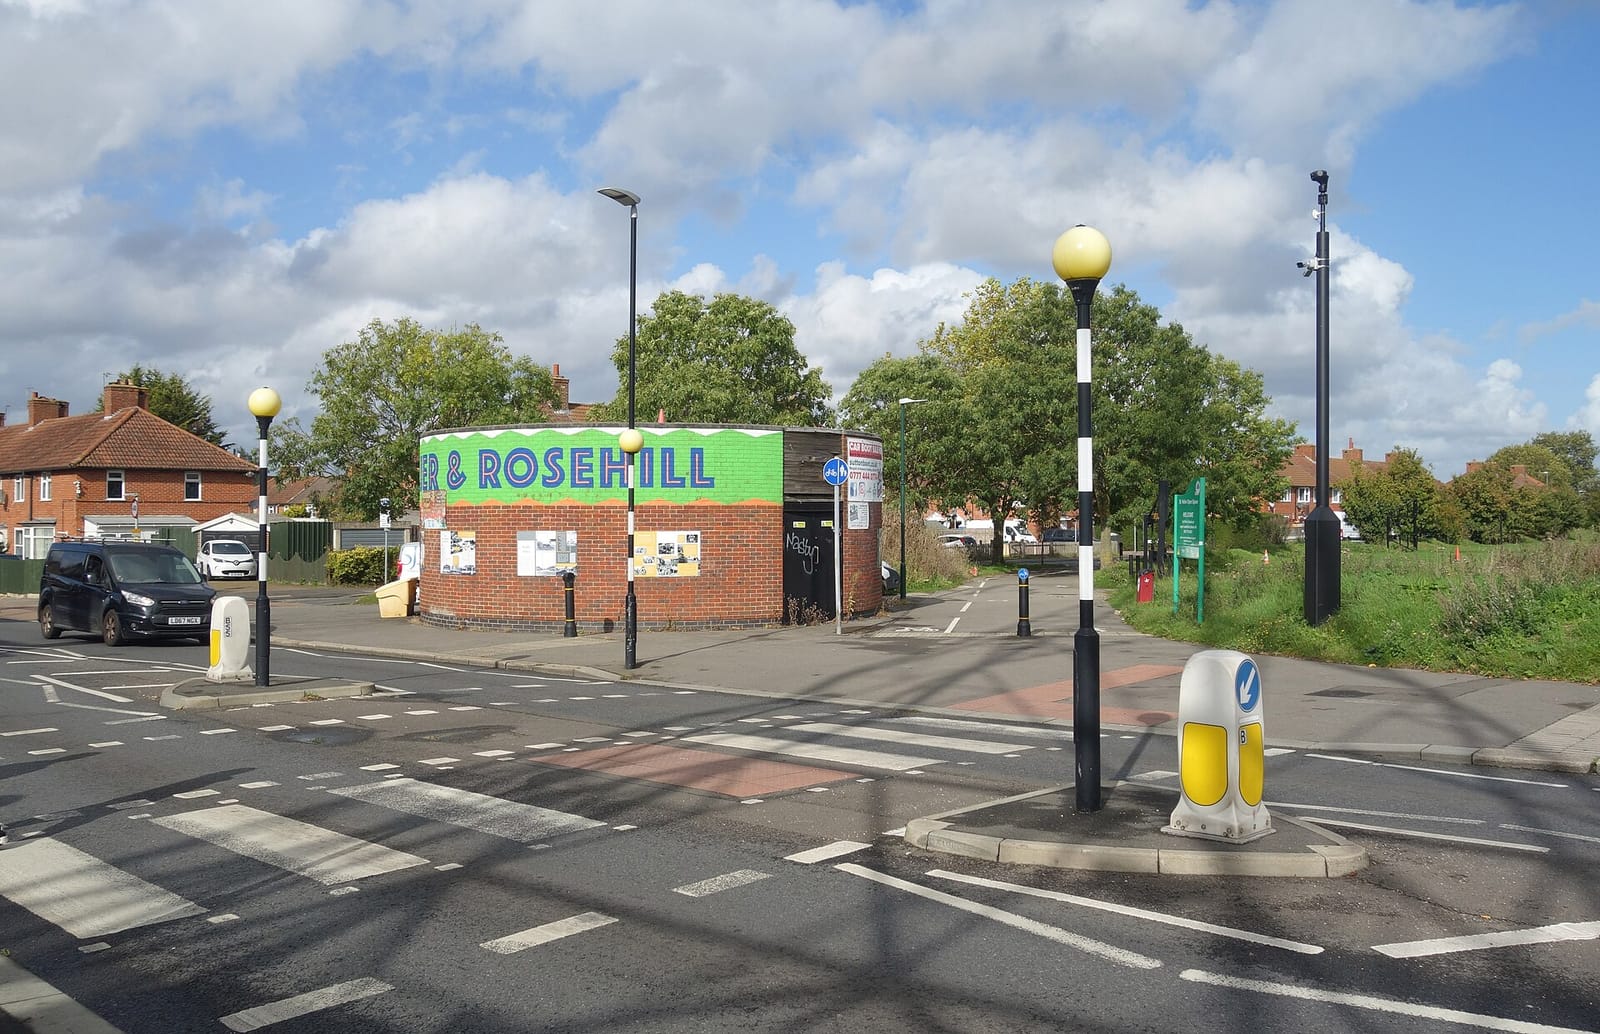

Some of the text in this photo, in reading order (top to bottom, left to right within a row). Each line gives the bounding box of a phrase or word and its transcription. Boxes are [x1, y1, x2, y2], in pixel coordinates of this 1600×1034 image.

[447, 450, 467, 490] &
[478, 447, 715, 488] ROSEHILL
[850, 471, 861, 479] 0777
[1241, 731, 1246, 743] B
